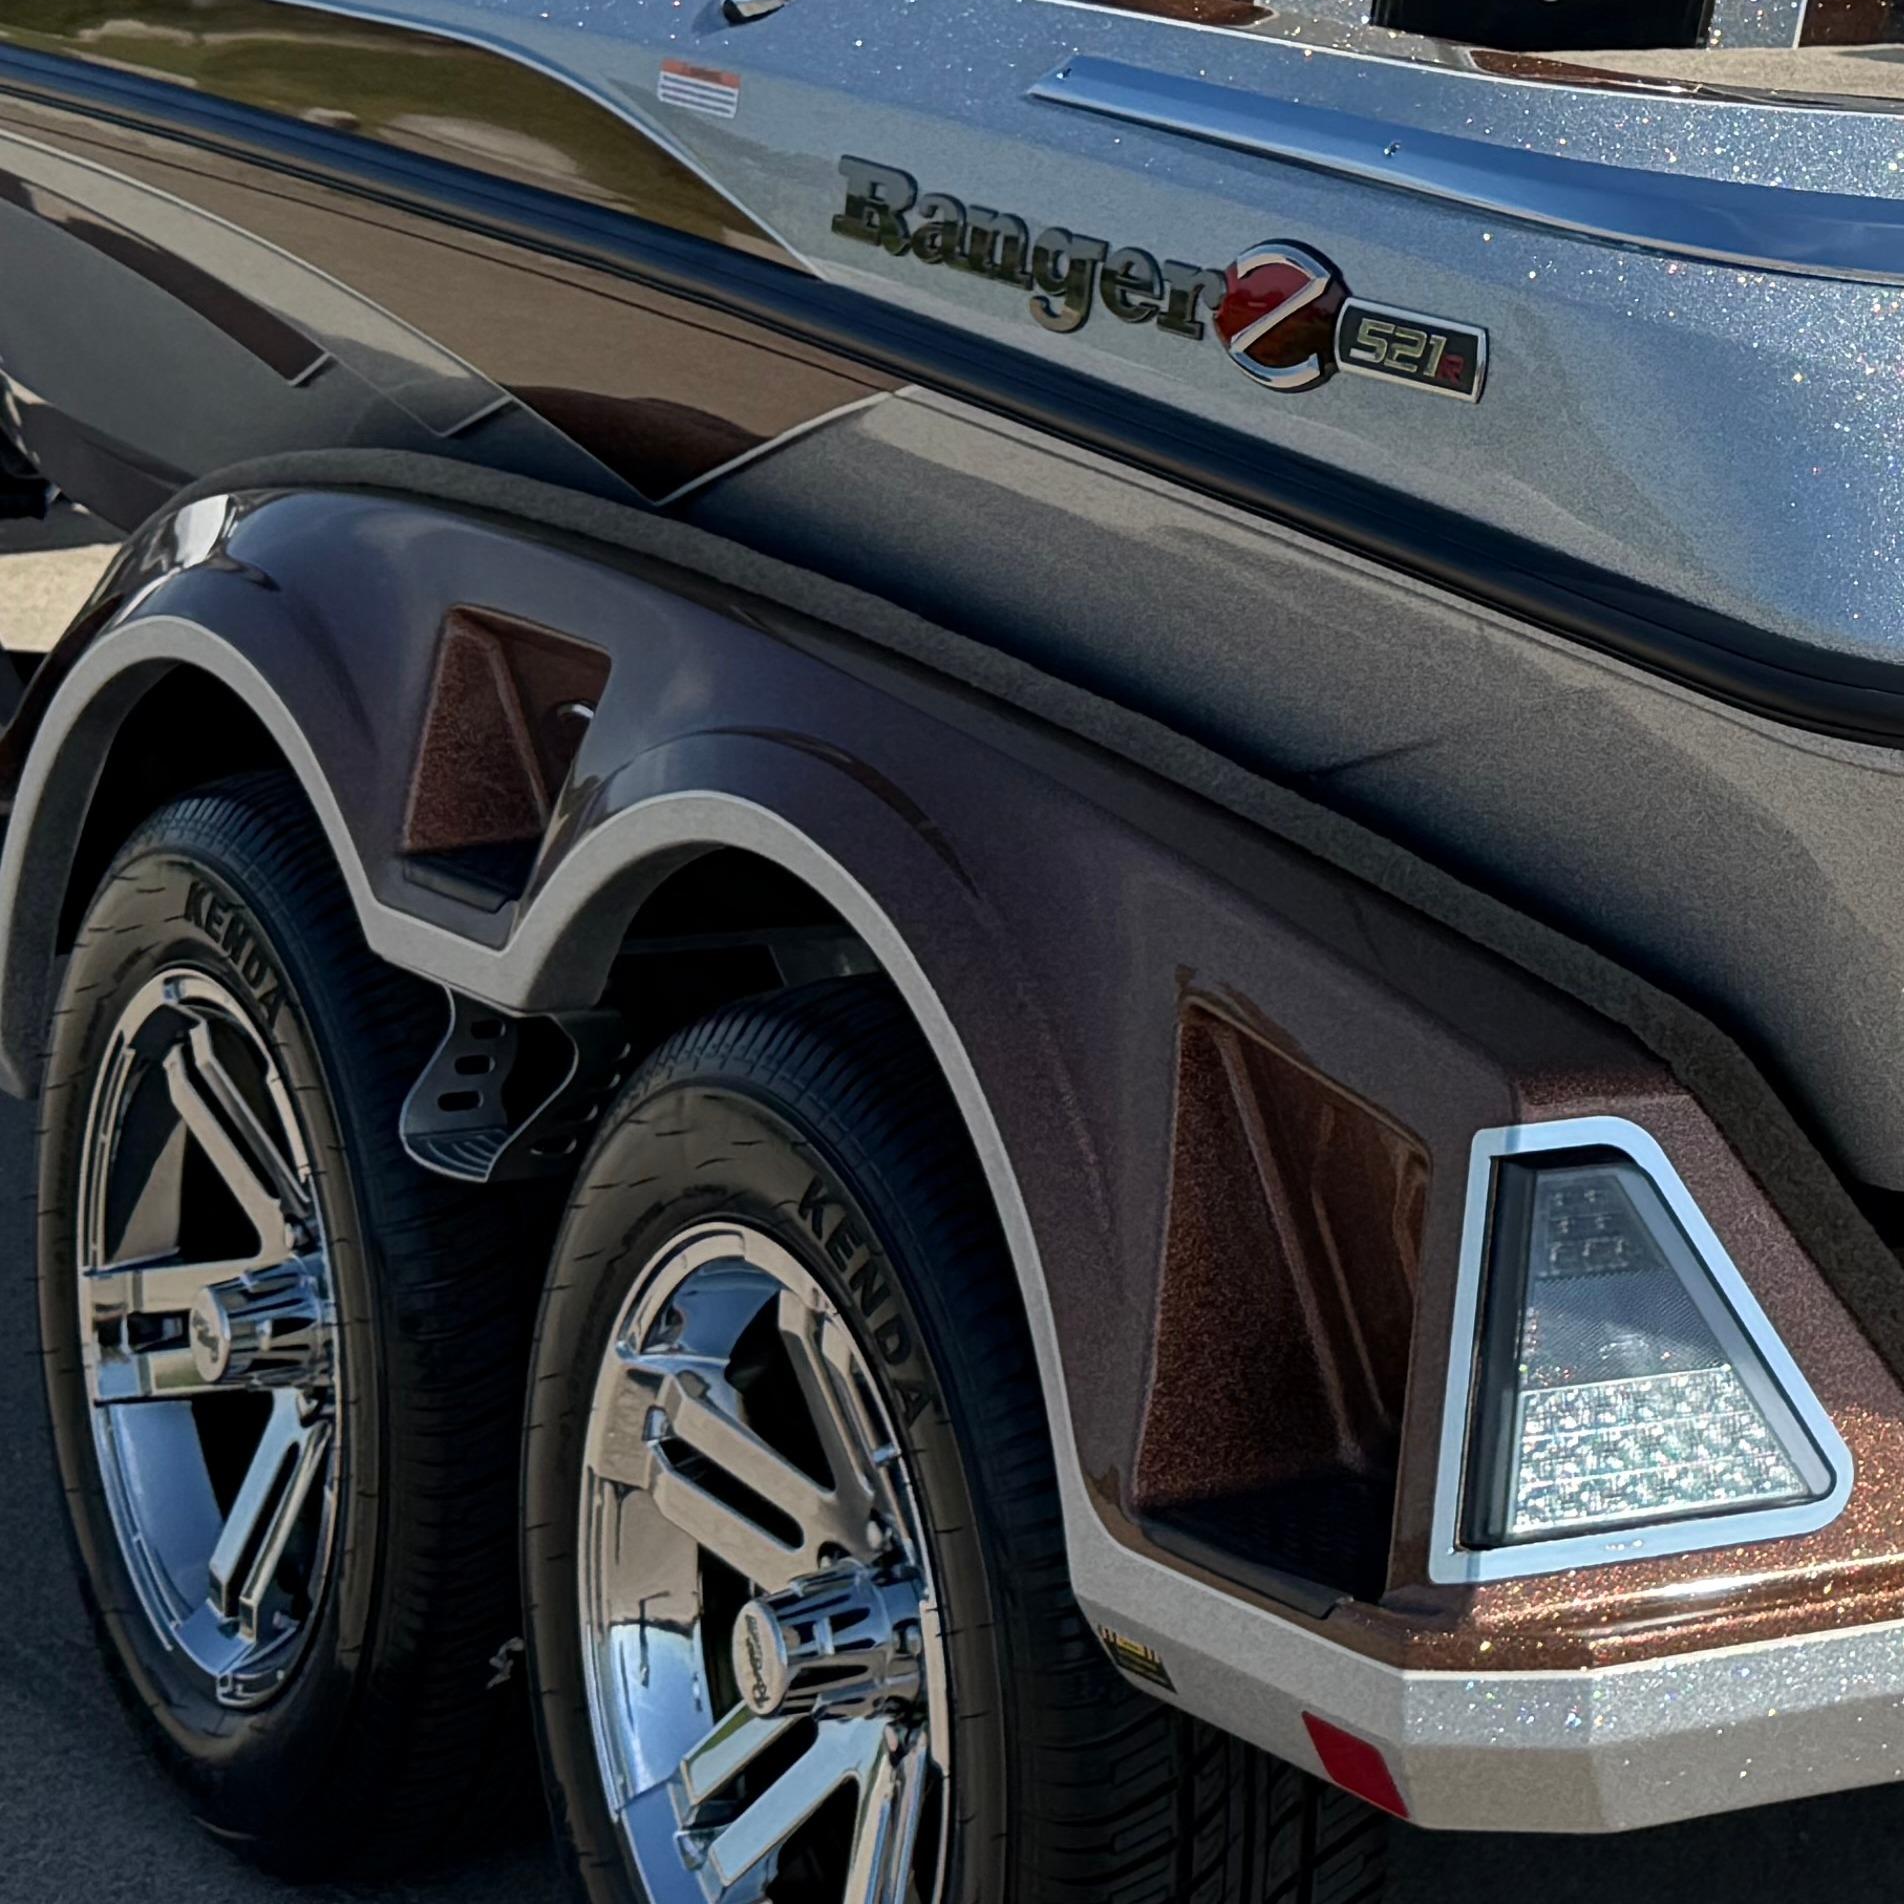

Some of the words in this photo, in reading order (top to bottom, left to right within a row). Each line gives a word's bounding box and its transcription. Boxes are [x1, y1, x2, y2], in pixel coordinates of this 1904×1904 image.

[831, 154, 1228, 341] Ranger
[184, 880, 300, 1034] KENDA
[797, 1175, 945, 1429] KENDA
